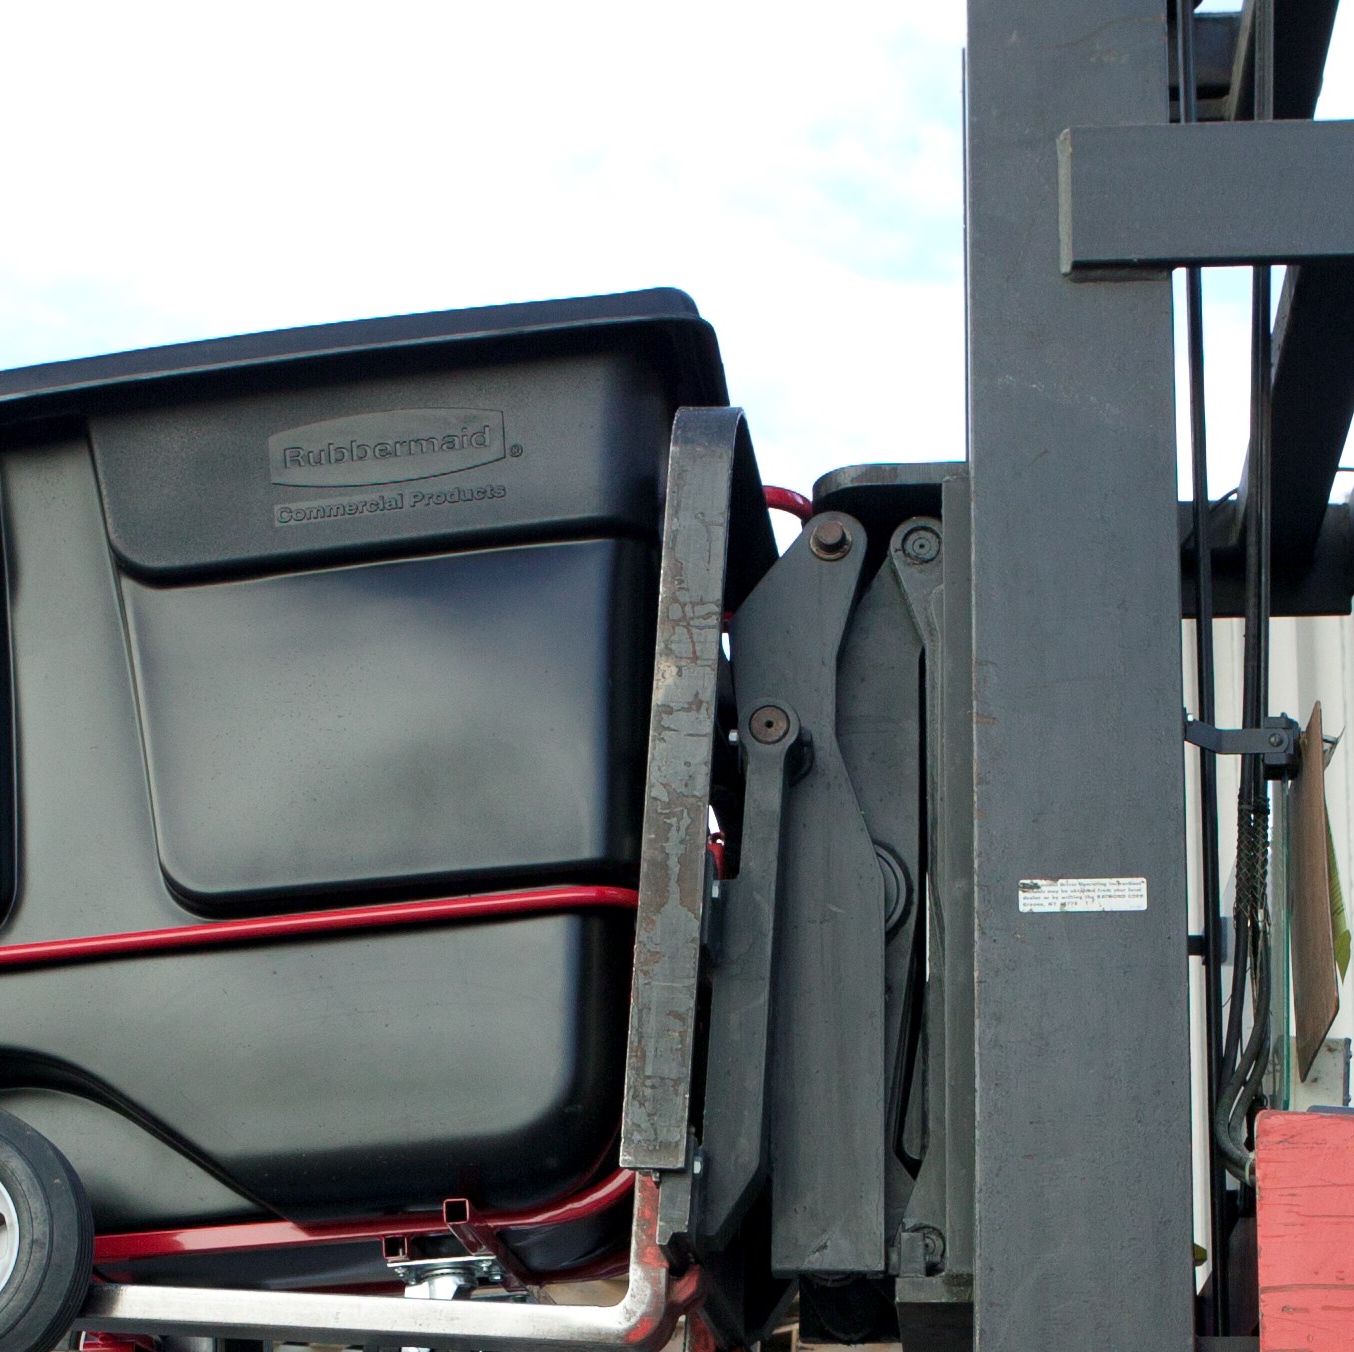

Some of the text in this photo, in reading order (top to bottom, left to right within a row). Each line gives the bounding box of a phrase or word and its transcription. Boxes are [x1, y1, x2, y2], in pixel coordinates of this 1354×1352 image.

[282, 424, 492, 470] Rubbermaid
[275, 484, 507, 525] Commercial Products
